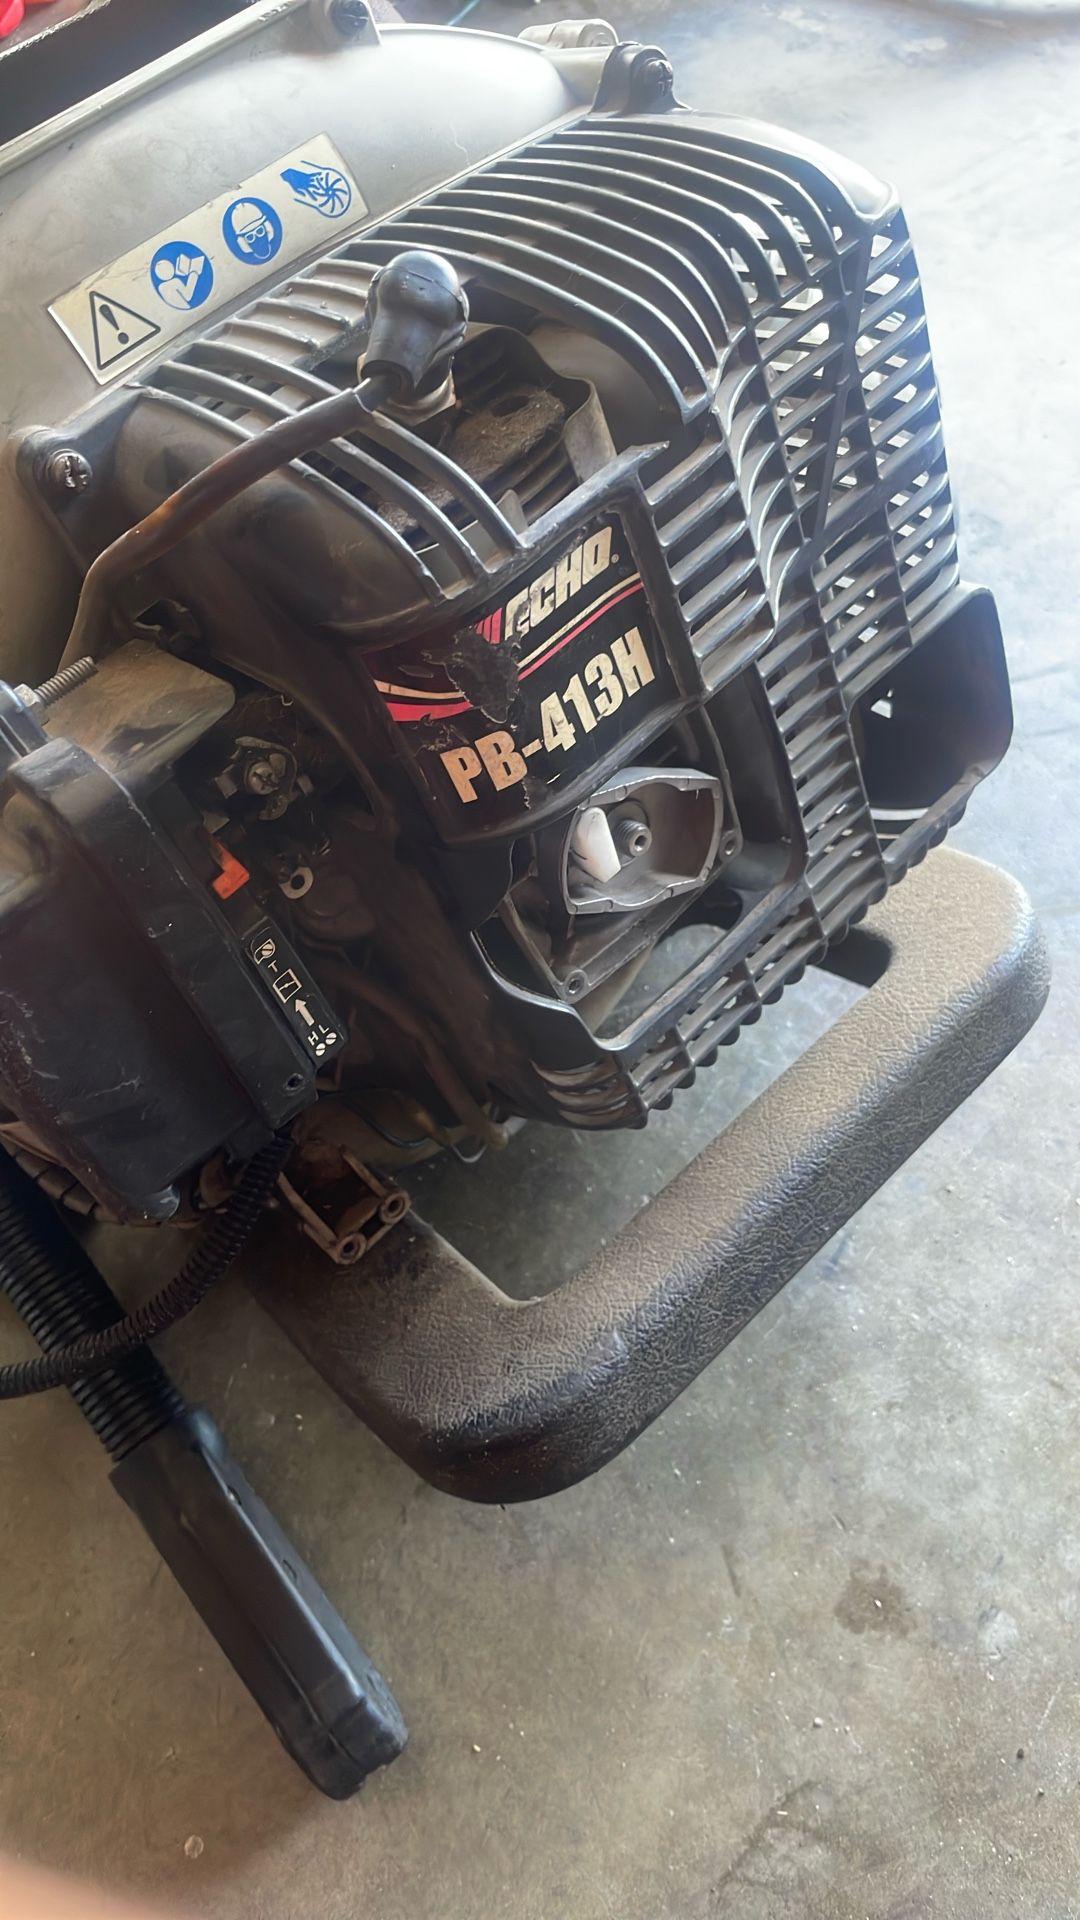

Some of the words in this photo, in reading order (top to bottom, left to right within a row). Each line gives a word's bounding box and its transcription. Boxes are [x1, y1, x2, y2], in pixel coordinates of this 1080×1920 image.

[440, 626, 655, 803] PB-413H
[267, 960, 278, 973] T
[307, 1031, 319, 1046] H
[318, 1025, 329, 1034] L
